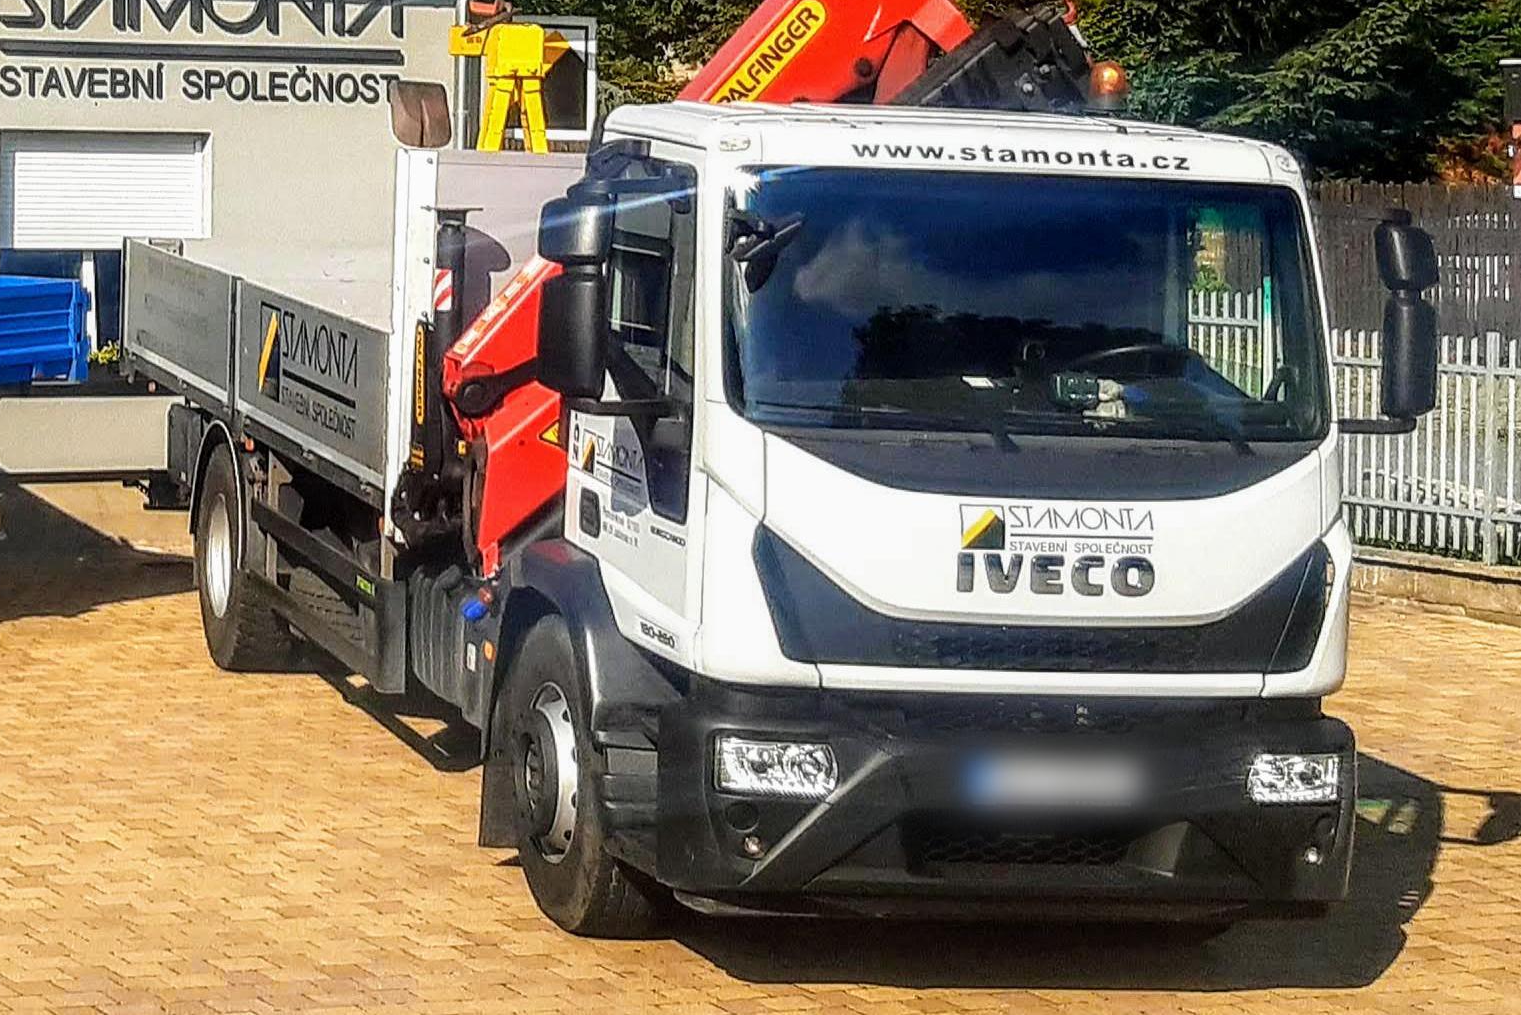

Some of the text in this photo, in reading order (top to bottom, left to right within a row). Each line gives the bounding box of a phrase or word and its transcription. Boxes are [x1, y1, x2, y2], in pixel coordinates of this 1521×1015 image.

[182, 65, 400, 105] SPOLEČNOST
[852, 143, 1191, 171] www.stamonta.cz
[282, 310, 358, 388] STAMONTA
[1009, 505, 1154, 531] STAMONTA
[1009, 541, 1153, 554] STAVEBNÍ SPOLEČNOST
[957, 552, 1155, 597] IVECO
